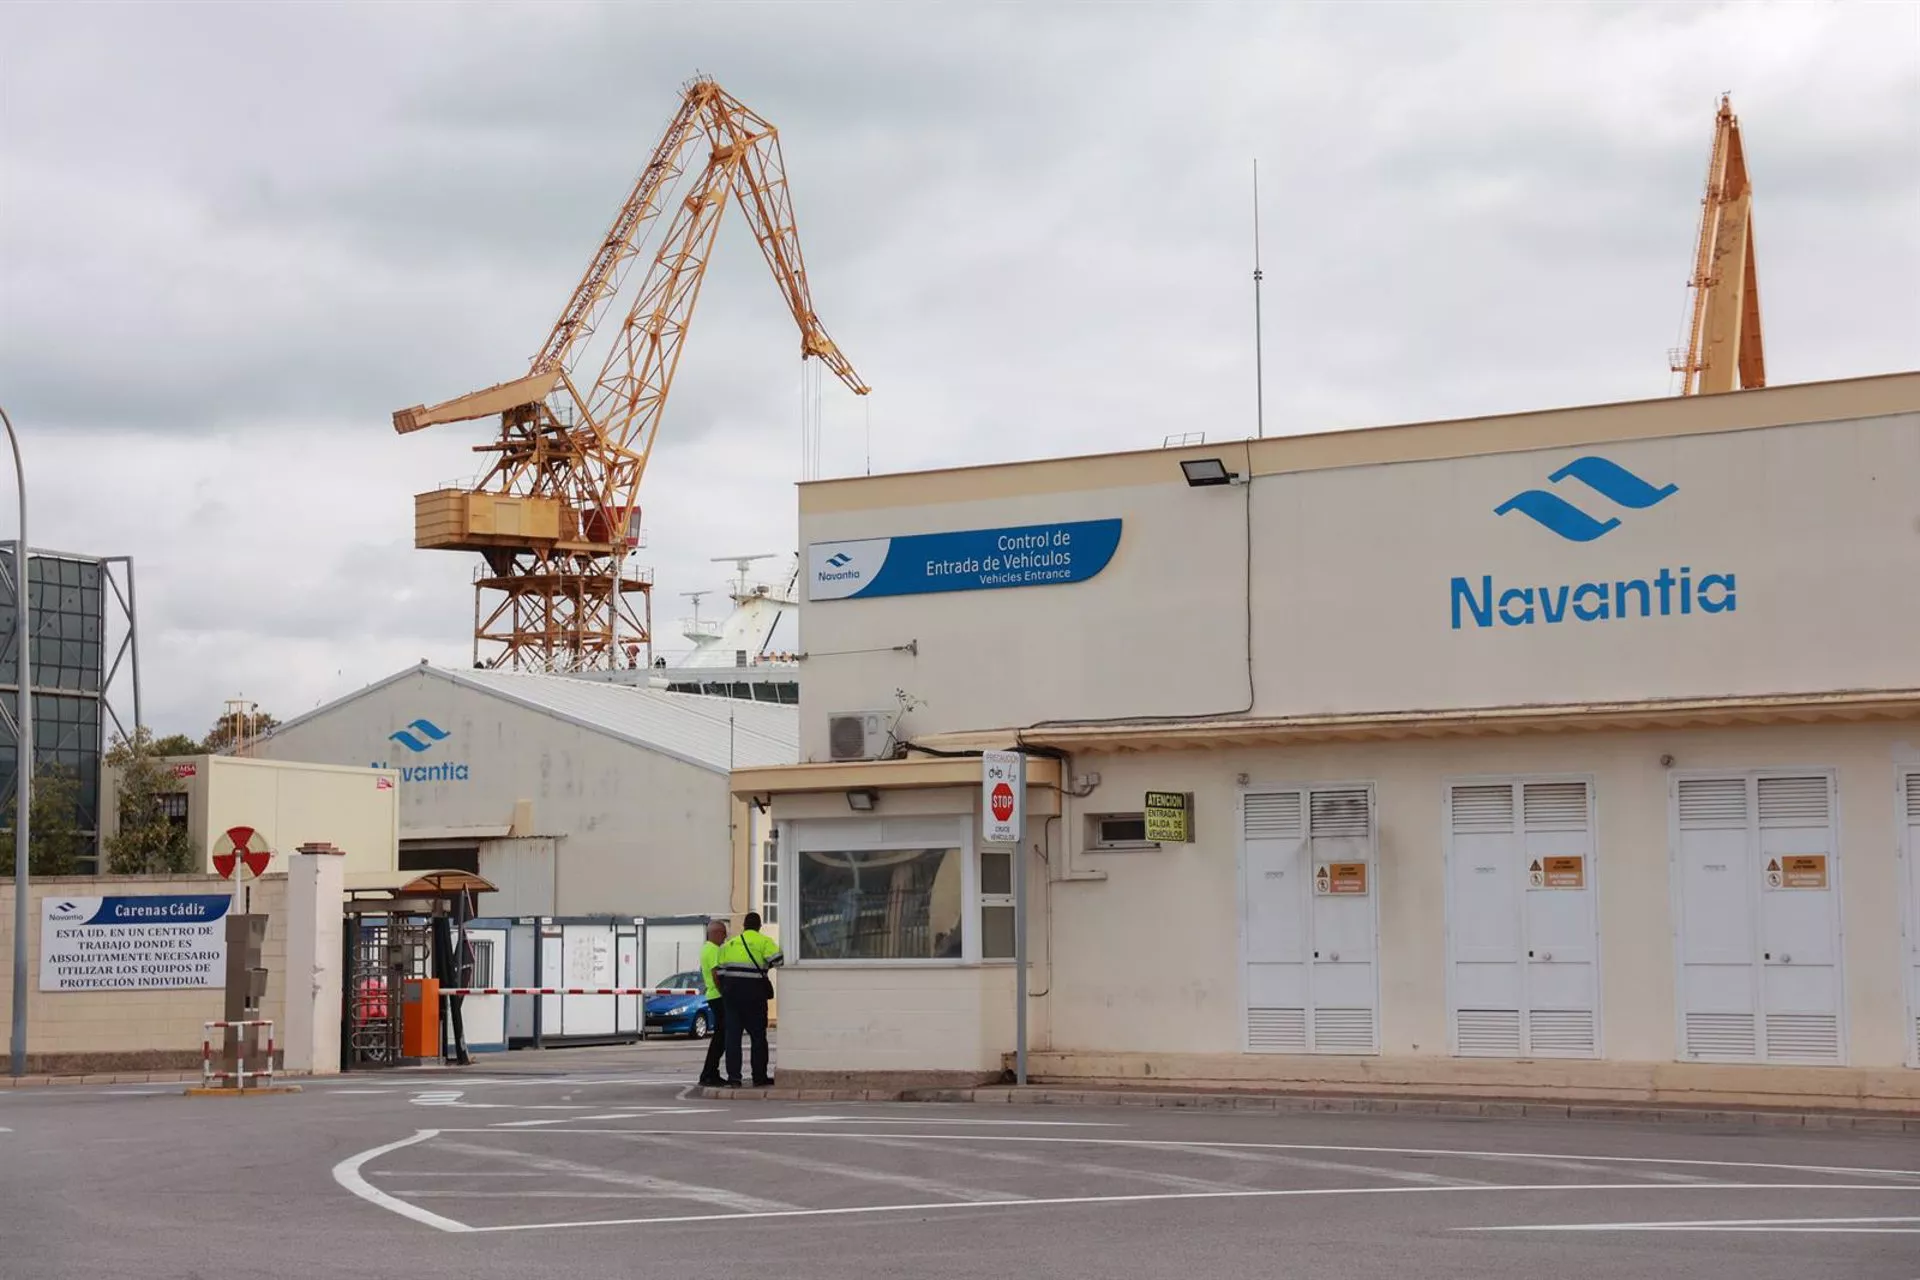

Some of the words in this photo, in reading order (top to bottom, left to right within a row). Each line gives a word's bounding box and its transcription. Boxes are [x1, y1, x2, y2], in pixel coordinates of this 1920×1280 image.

[998, 531, 1049, 551] Control
[1053, 530, 1070, 546] de
[926, 557, 979, 576] Entrada
[983, 555, 1000, 571] de
[1003, 550, 1071, 569] Vehículos
[818, 570, 860, 581] Navantia
[980, 573, 1022, 584] Vehicles
[1024, 569, 1071, 581] Entrance
[1450, 566, 1736, 630] Navantia
[371, 761, 468, 783] vantia
[993, 795, 1012, 809] STOP
[1148, 809, 1176, 818] ENTRADA
[1148, 819, 1170, 828] SALIDA
[1173, 820, 1182, 829] DE
[115, 904, 168, 917] Carenas
[169, 902, 205, 916] Cádiz
[49, 913, 84, 921] Navantia
[56, 929, 84, 938] ESTA
[87, 929, 107, 938] UD.
[110, 928, 125, 937] EN
[128, 928, 145, 937] UN
[148, 927, 194, 937] CENTRO
[198, 926, 213, 936] DE
[78, 941, 131, 951] TRABAJO
[133, 940, 176, 949] DONDE
[178, 939, 192, 948] ES
[49, 953, 152, 963] ABSOLUTAMENTE
[154, 952, 220, 962] NECESARIO
[57, 966, 113, 976] UTILIZAR
[116, 965, 138, 975] LOS
[141, 964, 192, 975] EQUIPOS
[194, 964, 211, 973] DE
[60, 977, 135, 988] PROTECCIÓN
[138, 976, 208, 986] INDIVIDUAL
